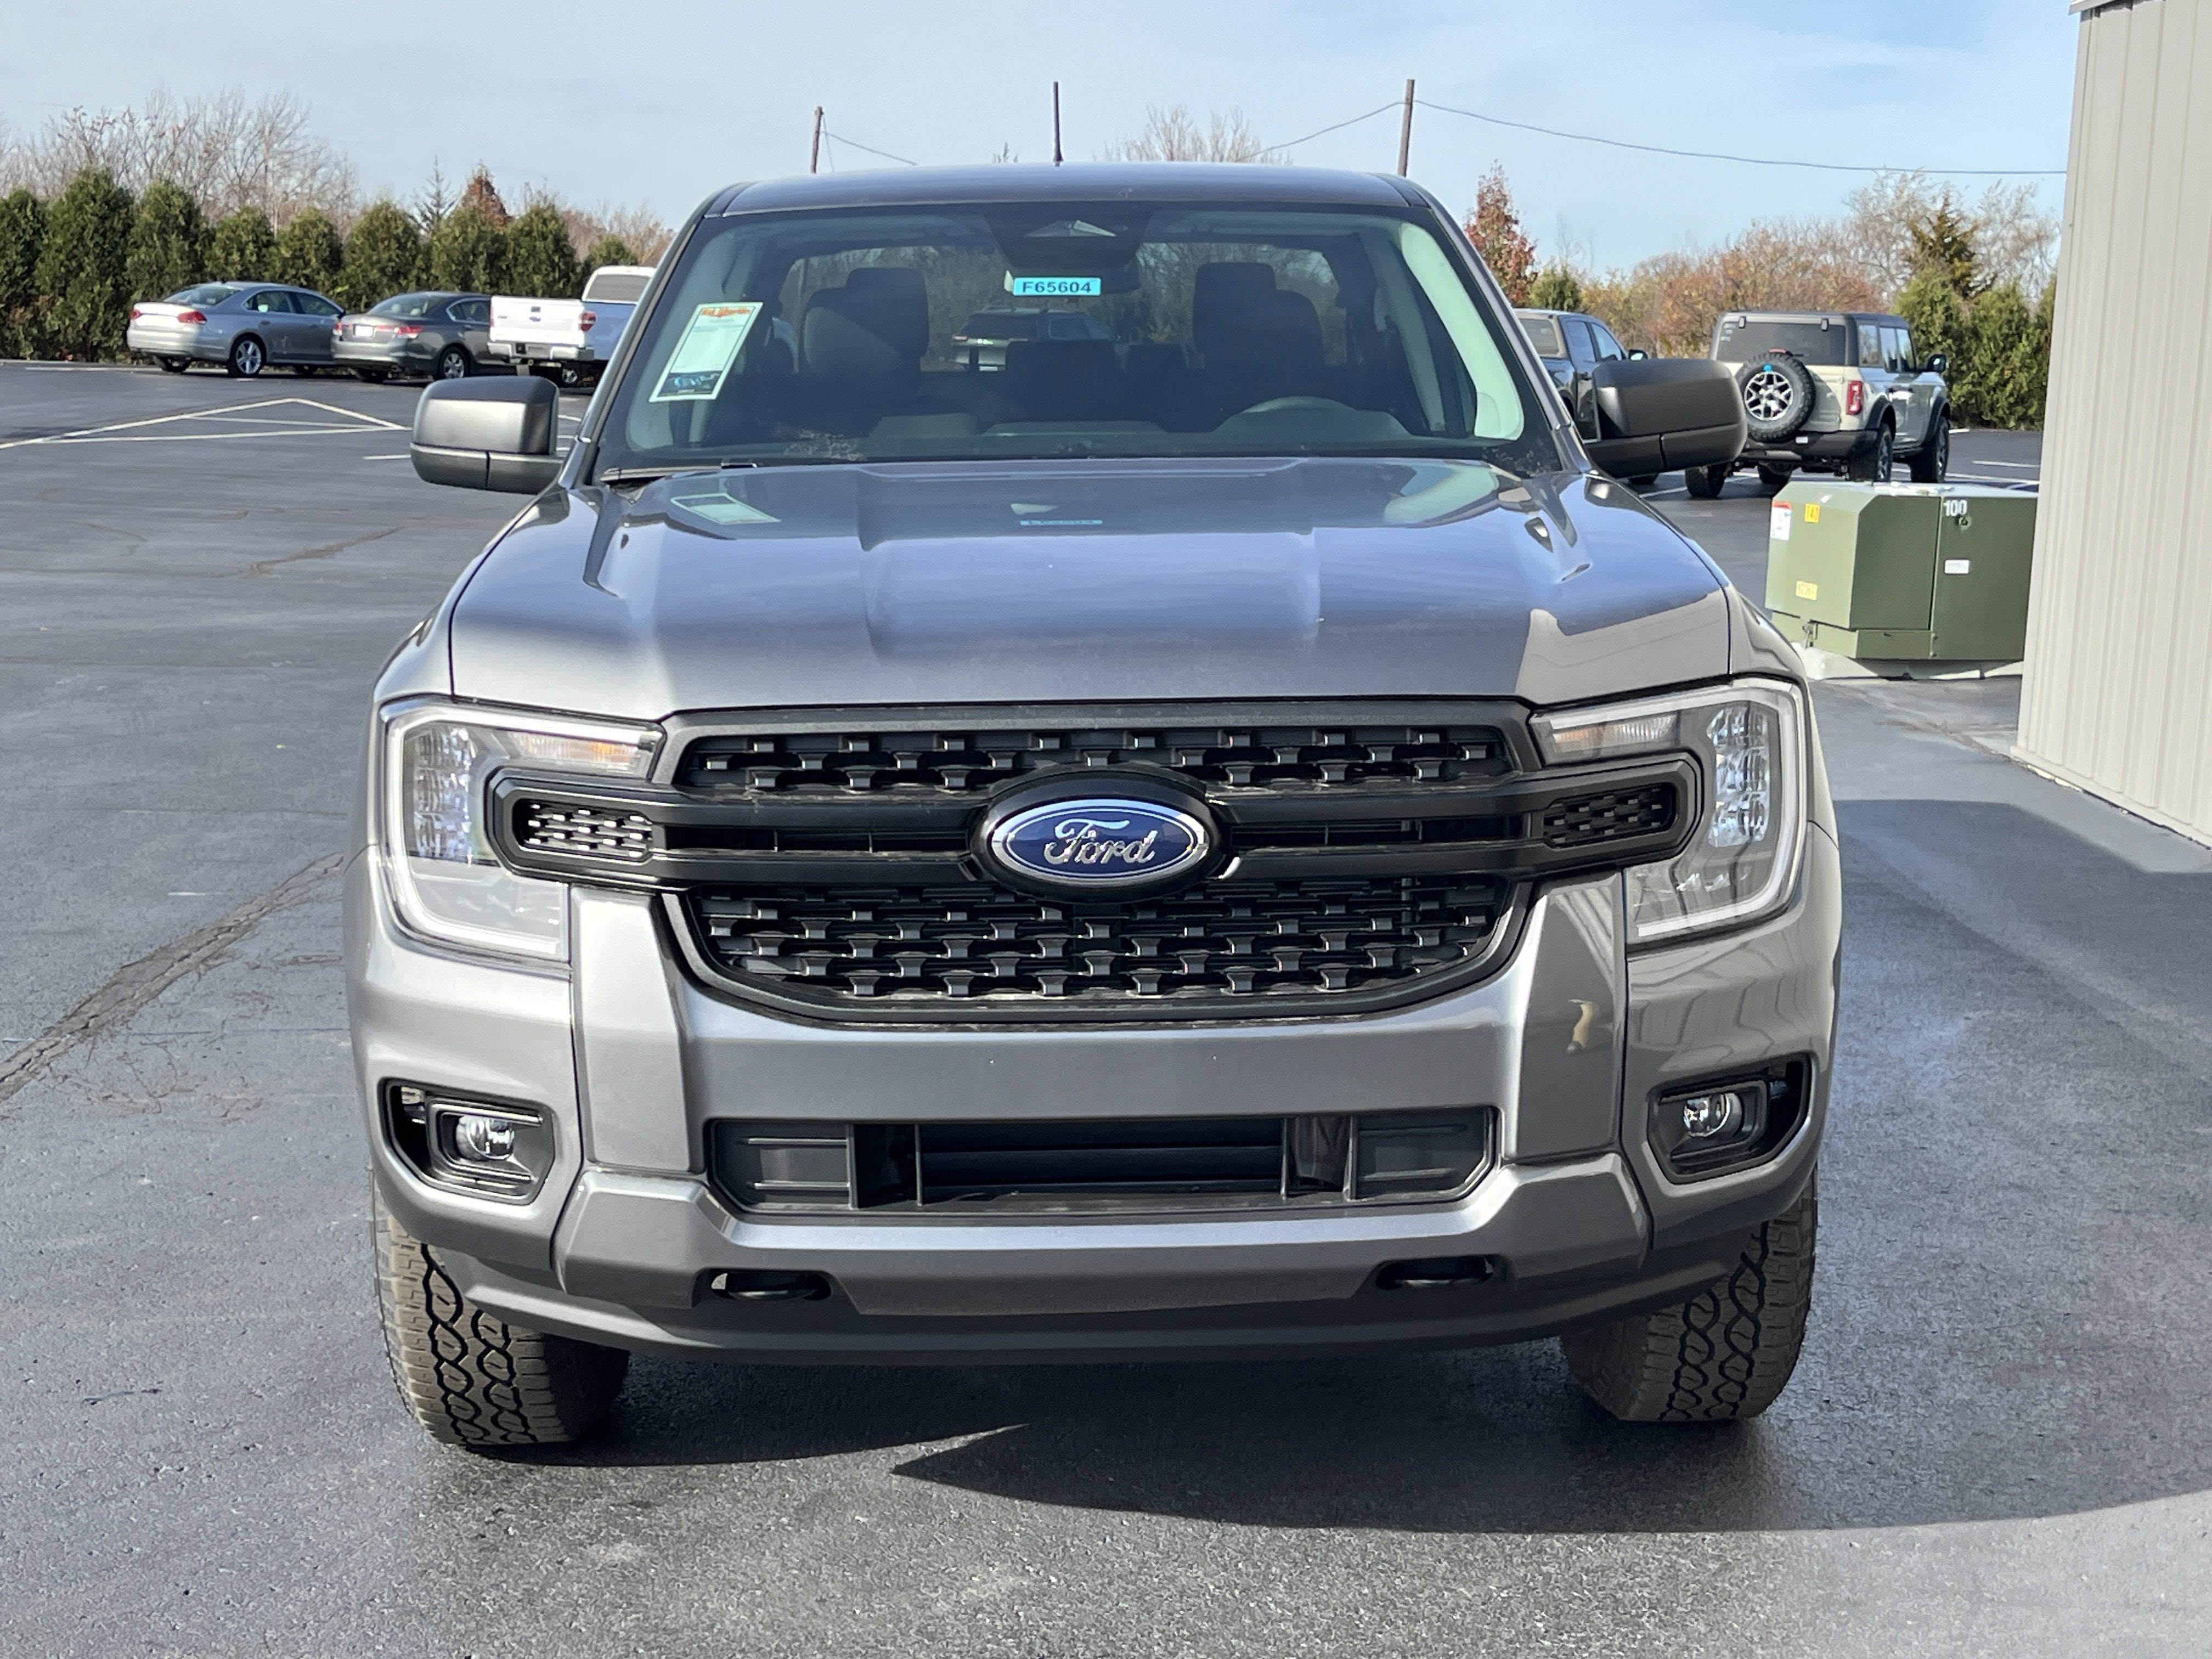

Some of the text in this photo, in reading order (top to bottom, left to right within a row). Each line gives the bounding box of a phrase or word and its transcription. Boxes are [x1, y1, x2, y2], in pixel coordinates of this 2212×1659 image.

[1023, 281, 1091, 293] F65604
[1943, 500, 1968, 516] 100
[1043, 818, 1158, 865] Ford
